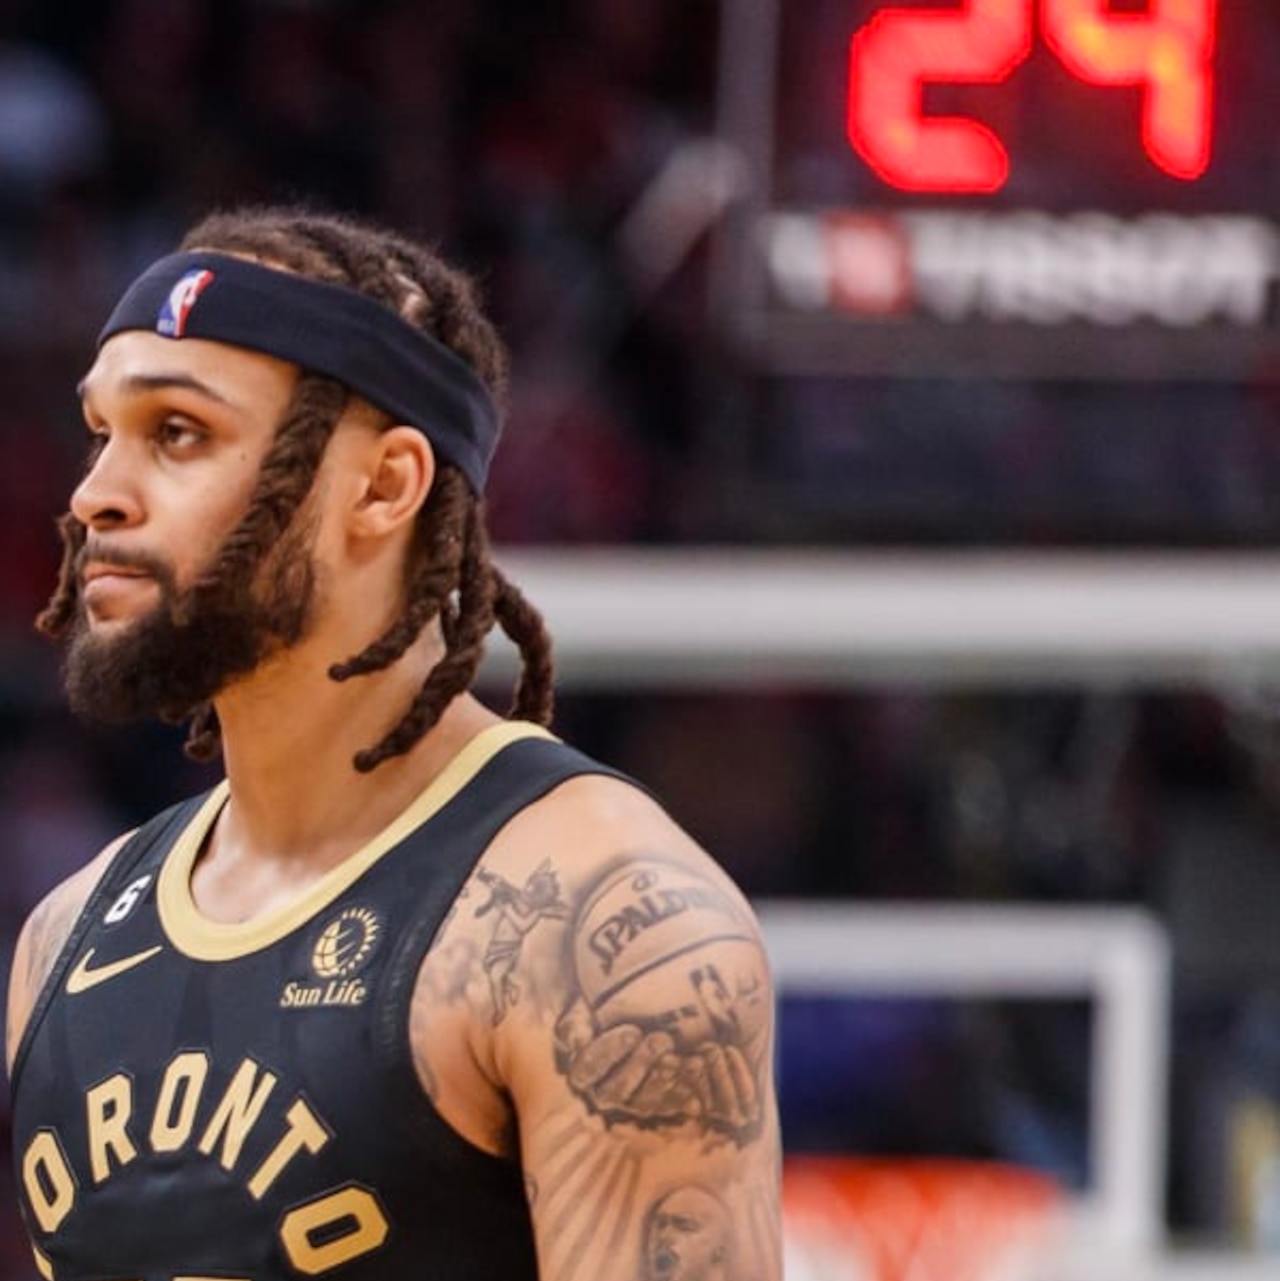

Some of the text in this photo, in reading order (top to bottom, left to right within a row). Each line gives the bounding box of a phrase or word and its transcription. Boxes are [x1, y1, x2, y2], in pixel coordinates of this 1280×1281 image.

[847, 0, 1219, 193] 24
[102, 873, 151, 926] 6
[280, 978, 366, 1007] Sun Life
